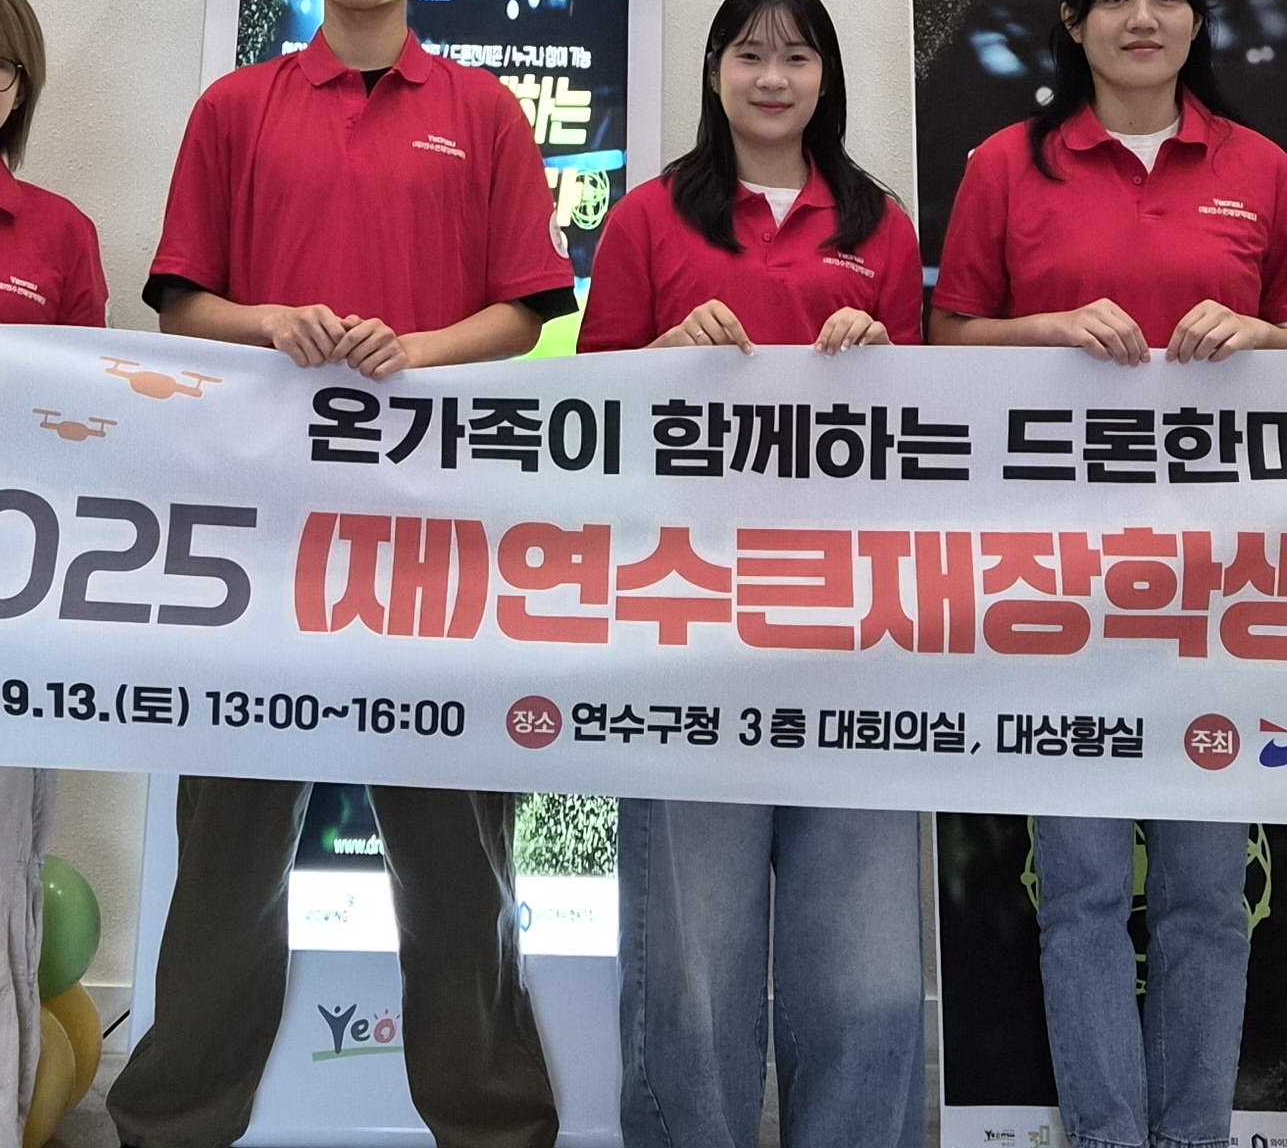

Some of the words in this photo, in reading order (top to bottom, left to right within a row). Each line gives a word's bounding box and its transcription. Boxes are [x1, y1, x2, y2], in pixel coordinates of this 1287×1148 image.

[308, 387, 620, 475] 온가족이
[651, 400, 971, 481] 함께하는
[204, 690, 466, 738] 13:00~16:00
[512, 710, 556, 736] 장소
[570, 702, 720, 746] 연수구청
[817, 709, 981, 755] 대회의실,
[996, 713, 1144, 758] 대상황실
[1190, 729, 1234, 755] 주최
